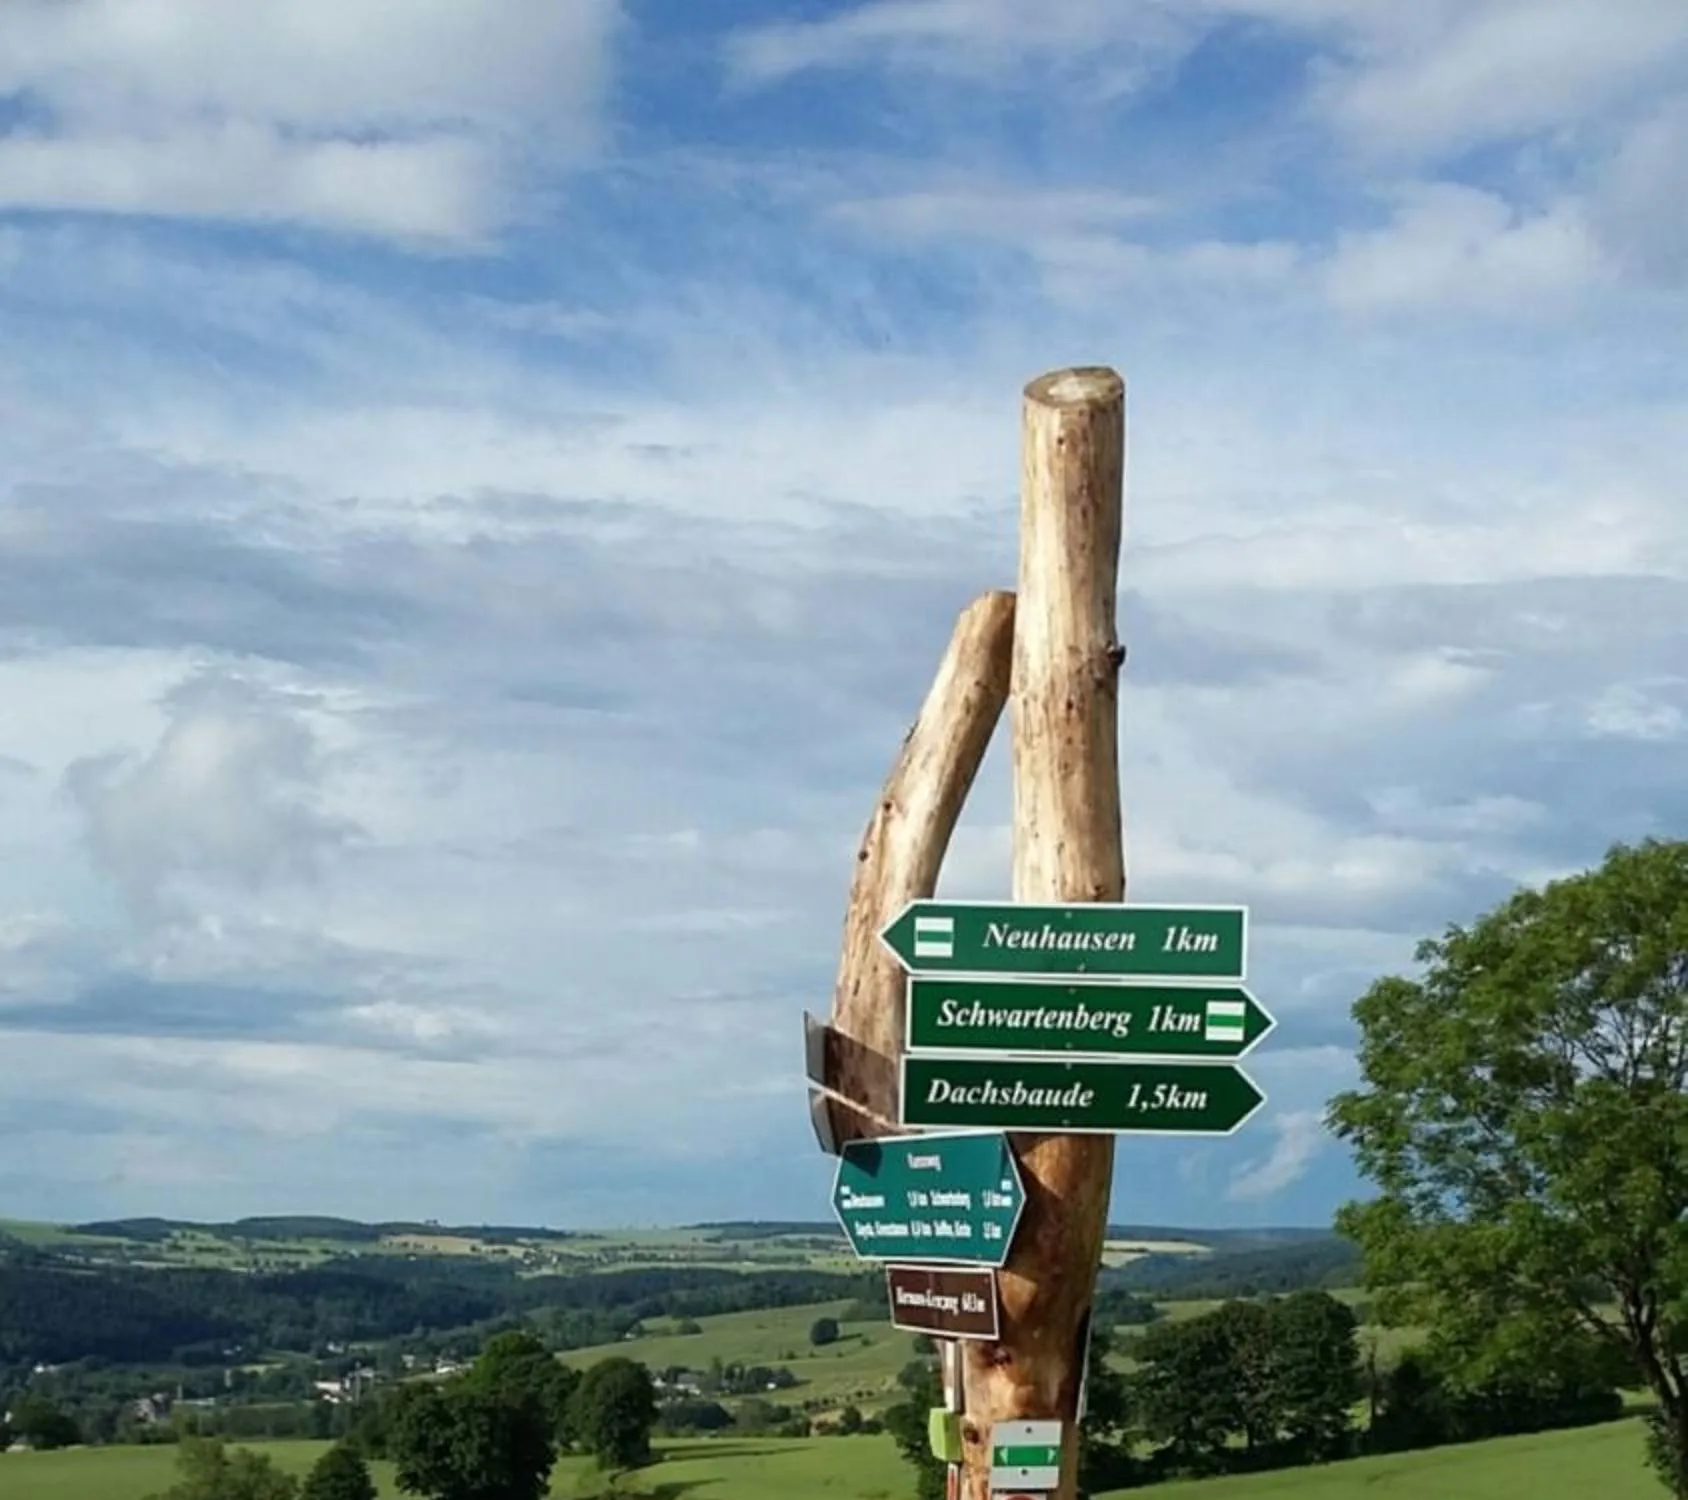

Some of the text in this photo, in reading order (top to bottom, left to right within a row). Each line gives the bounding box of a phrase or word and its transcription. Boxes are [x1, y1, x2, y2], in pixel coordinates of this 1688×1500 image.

[983, 923, 1218, 951] Neuhausen 1km
[936, 999, 1201, 1037] Schwartenberg 1km
[926, 1079, 1208, 1109] Dachsbaude 1,5km
